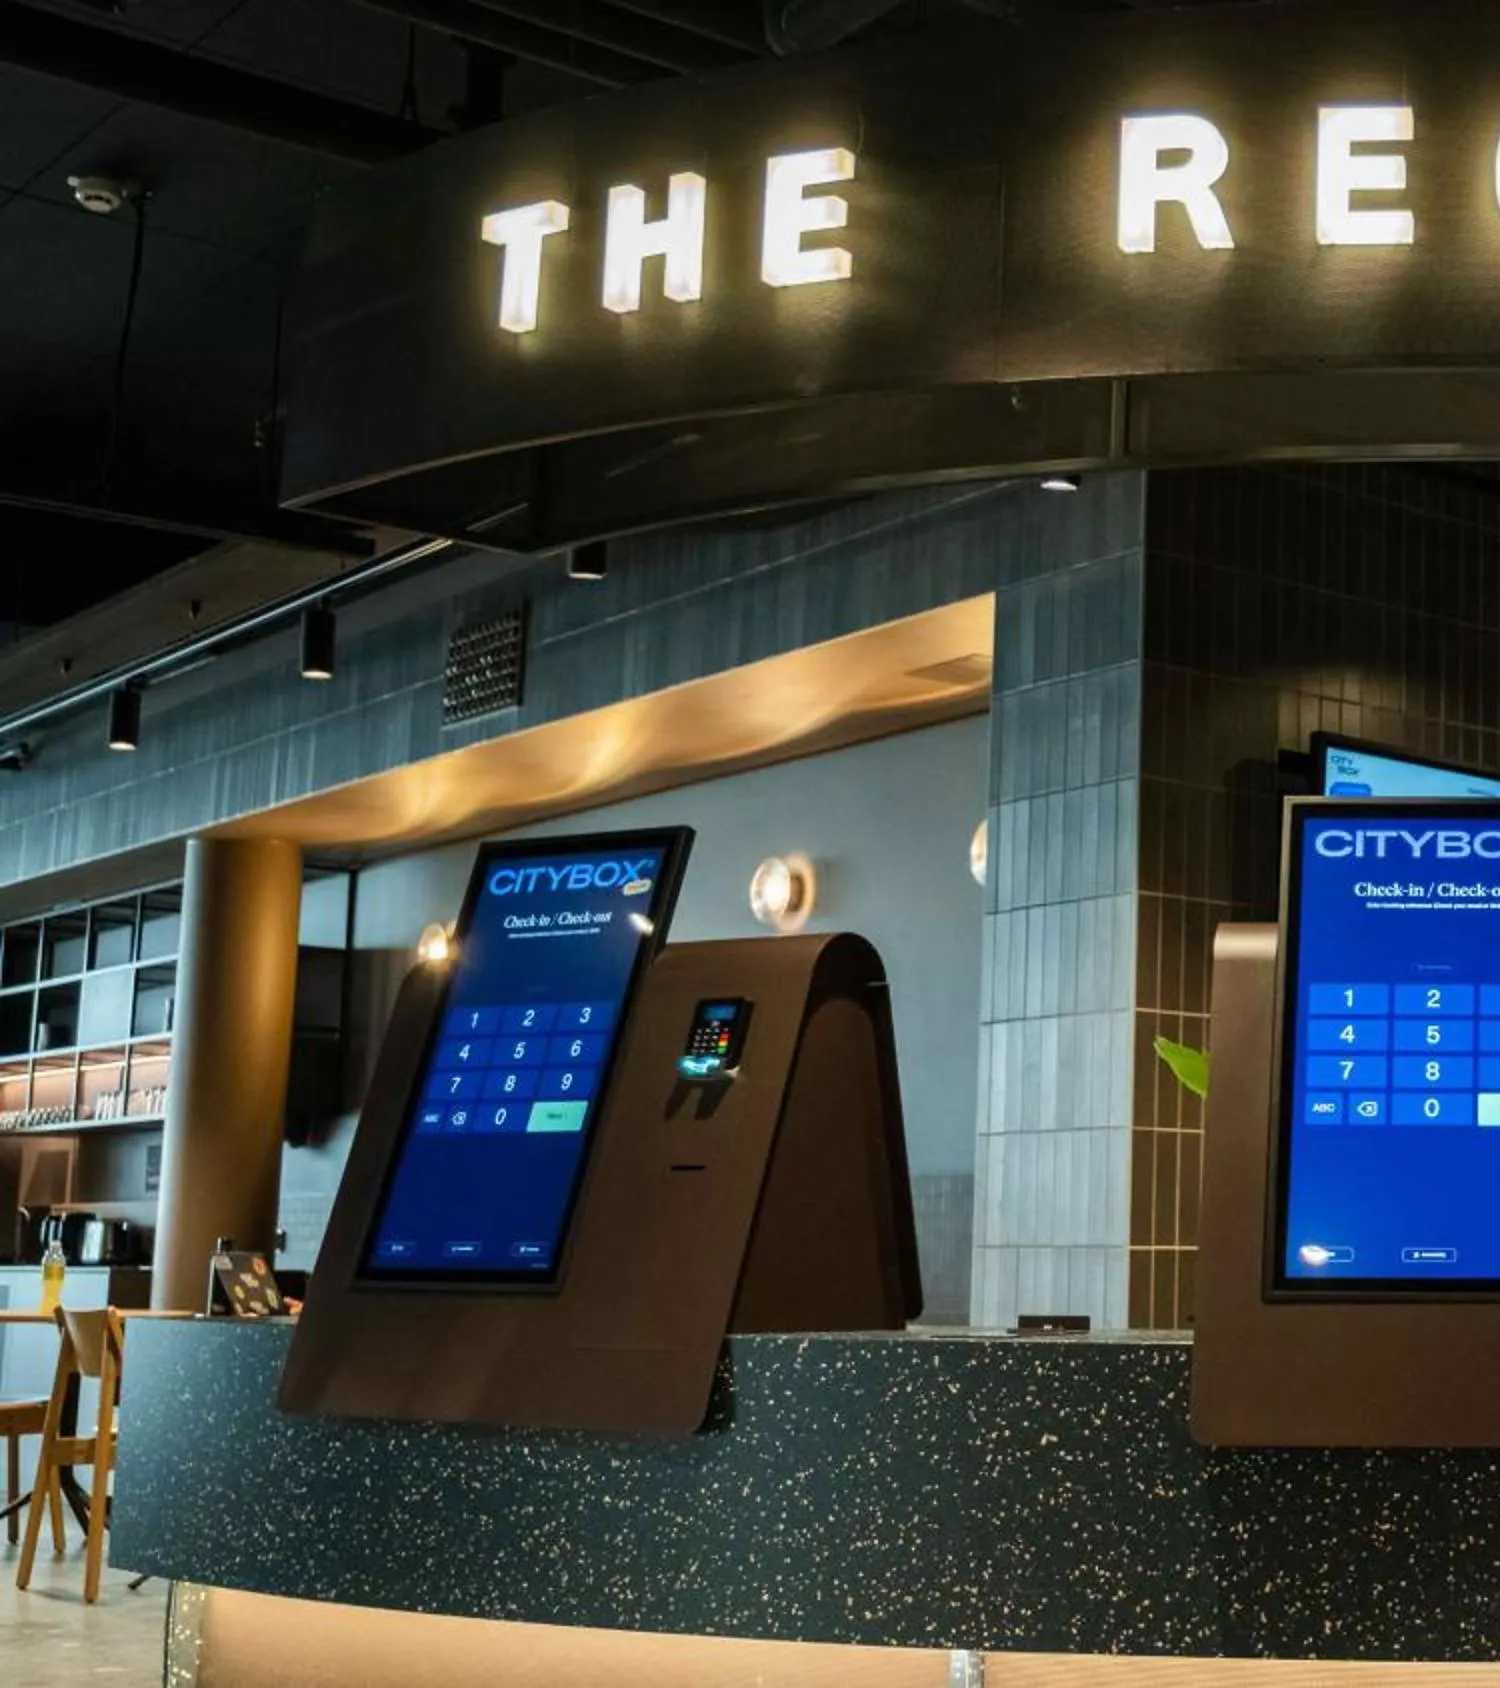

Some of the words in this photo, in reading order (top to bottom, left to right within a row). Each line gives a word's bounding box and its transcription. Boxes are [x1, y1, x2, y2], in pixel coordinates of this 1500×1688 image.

[481, 147, 855, 334] THE
[1353, 882, 1425, 897] Check-in
[1343, 989, 1353, 1007] 1
[1427, 989, 1441, 1008] 2
[471, 1012, 479, 1028] 1
[522, 1009, 535, 1027] 2
[579, 1007, 592, 1024] 3
[1340, 1024, 1355, 1043] 4
[1426, 1025, 1441, 1044] 5
[459, 1044, 470, 1060] 4
[513, 1041, 526, 1059] 5
[570, 1039, 582, 1057] 6
[1339, 1060, 1355, 1080] 7
[1425, 1061, 1441, 1081] 8
[451, 1076, 462, 1093] 7
[504, 1074, 517, 1092] 8
[561, 1073, 573, 1091] 9
[1423, 1098, 1440, 1118] 0
